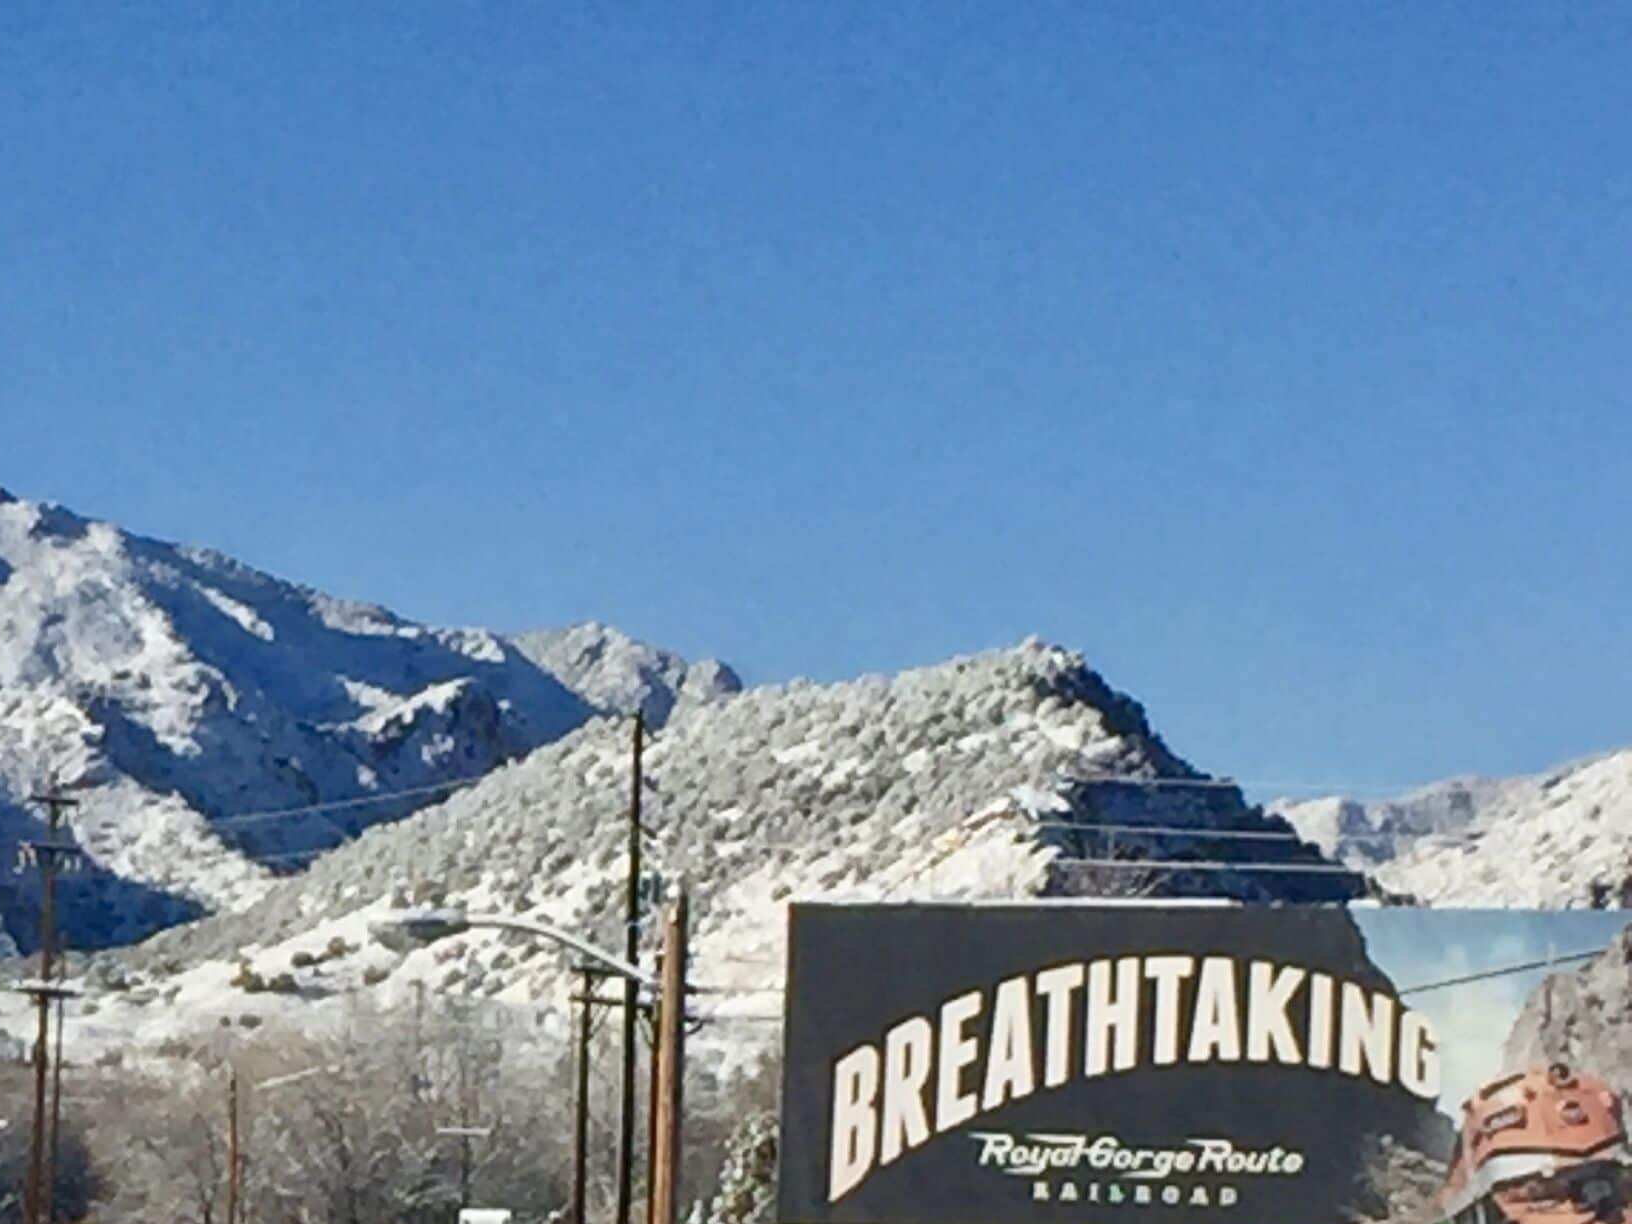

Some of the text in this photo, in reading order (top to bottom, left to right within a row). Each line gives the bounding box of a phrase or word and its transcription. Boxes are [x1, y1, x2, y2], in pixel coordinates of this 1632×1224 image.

[828, 955, 1441, 1202] BREATHTAKING
[969, 1132, 1305, 1179] Royal Gorge Route
[1032, 1182, 1238, 1206] RAILROAD
